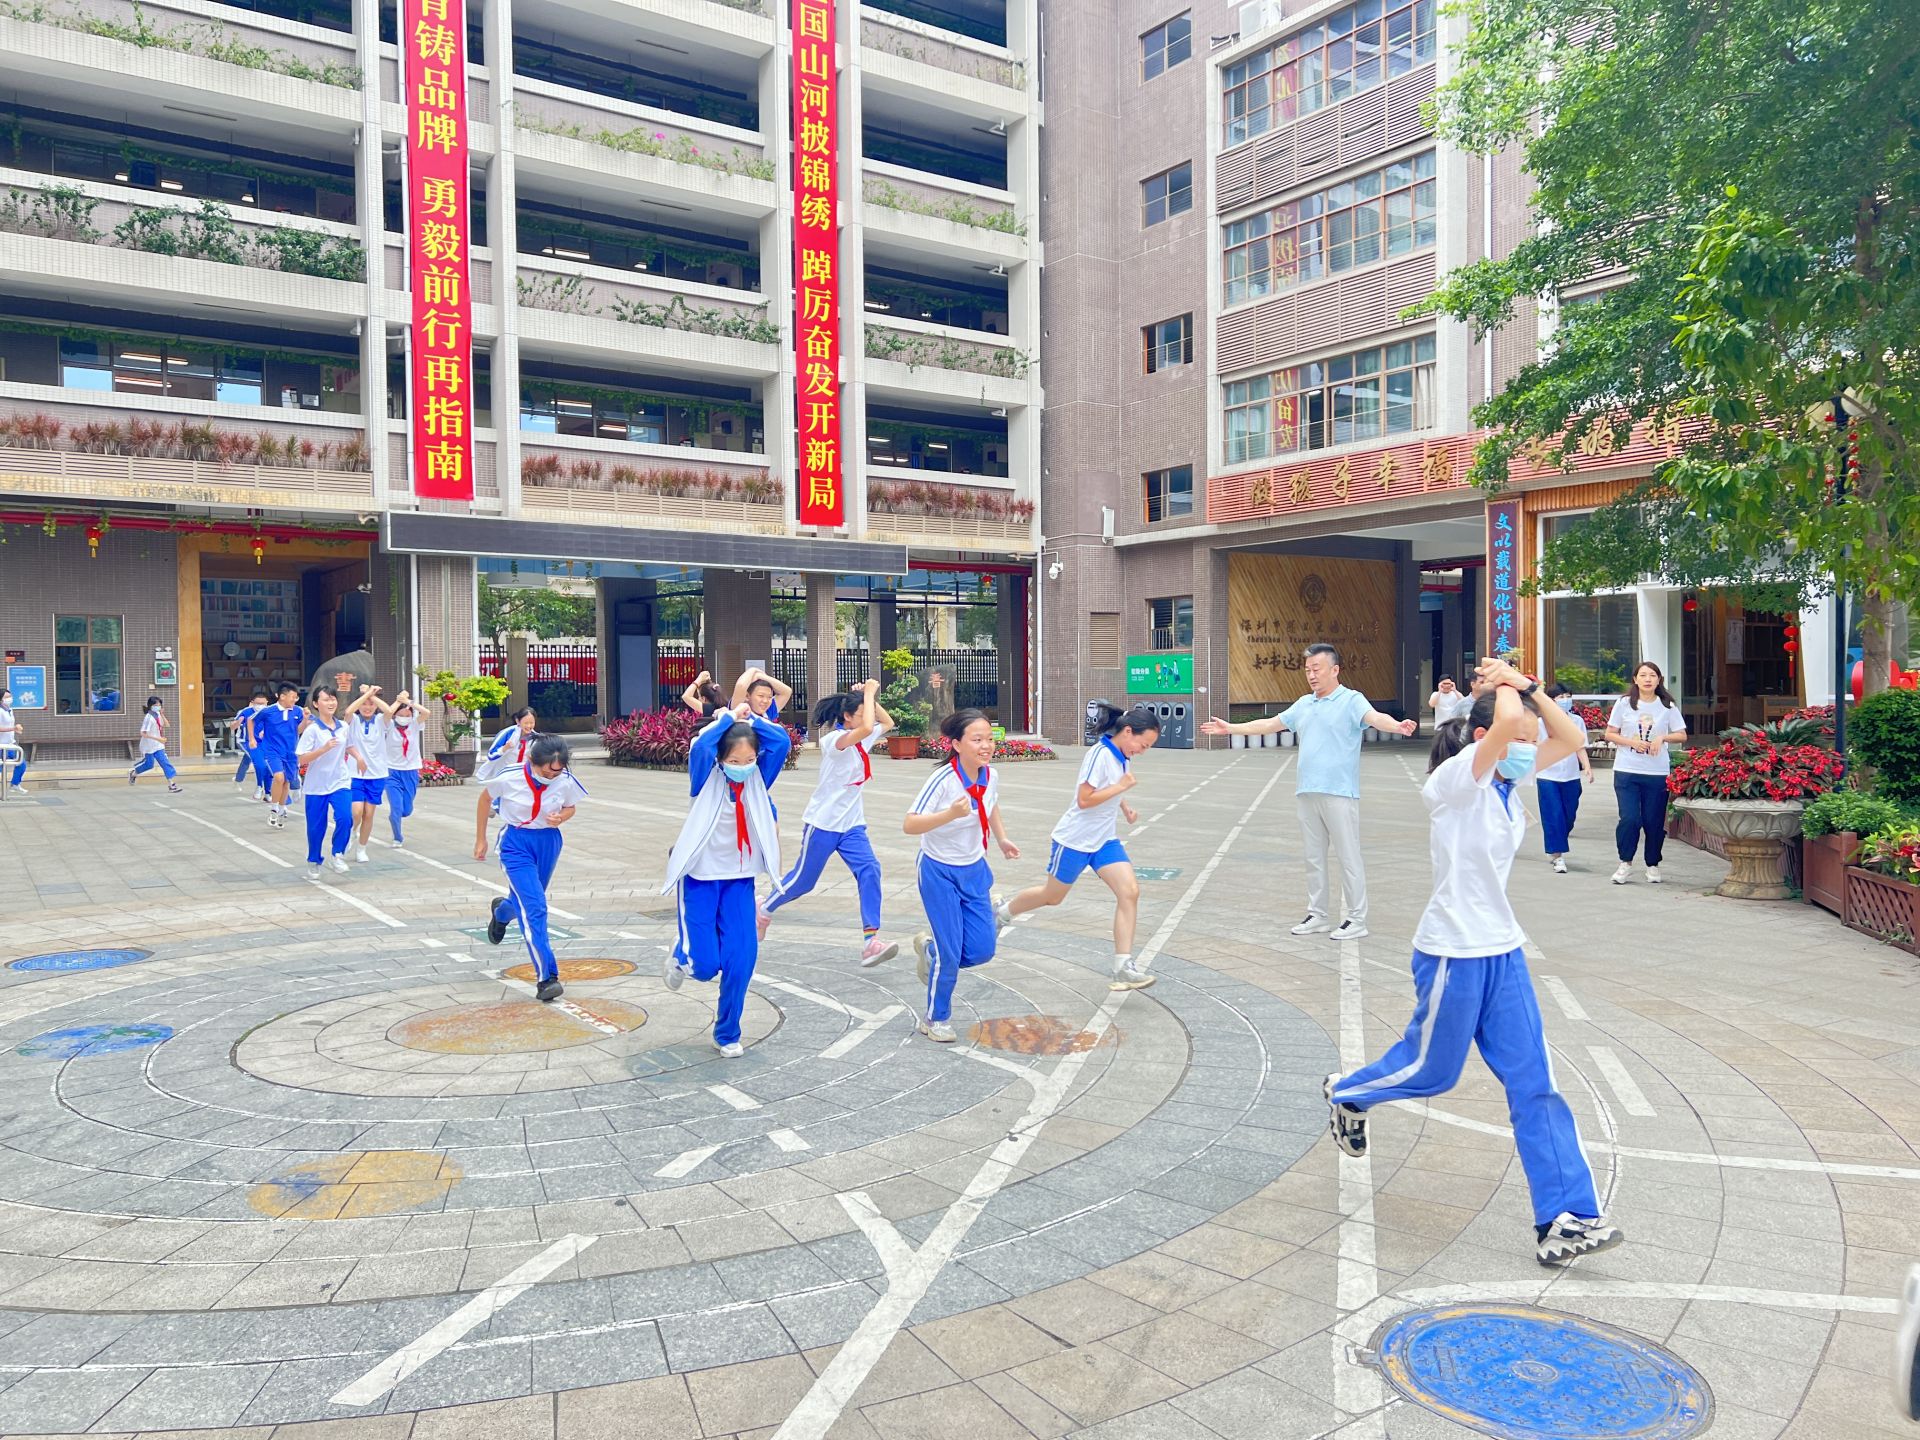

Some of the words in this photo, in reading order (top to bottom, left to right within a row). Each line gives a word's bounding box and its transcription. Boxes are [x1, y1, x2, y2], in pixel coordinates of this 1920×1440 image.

[800, 0, 831, 231] 国山河披锦绣
[420, 176, 464, 482] 勇毅前行再指南
[802, 248, 836, 510] 踔厉奋发开新局
